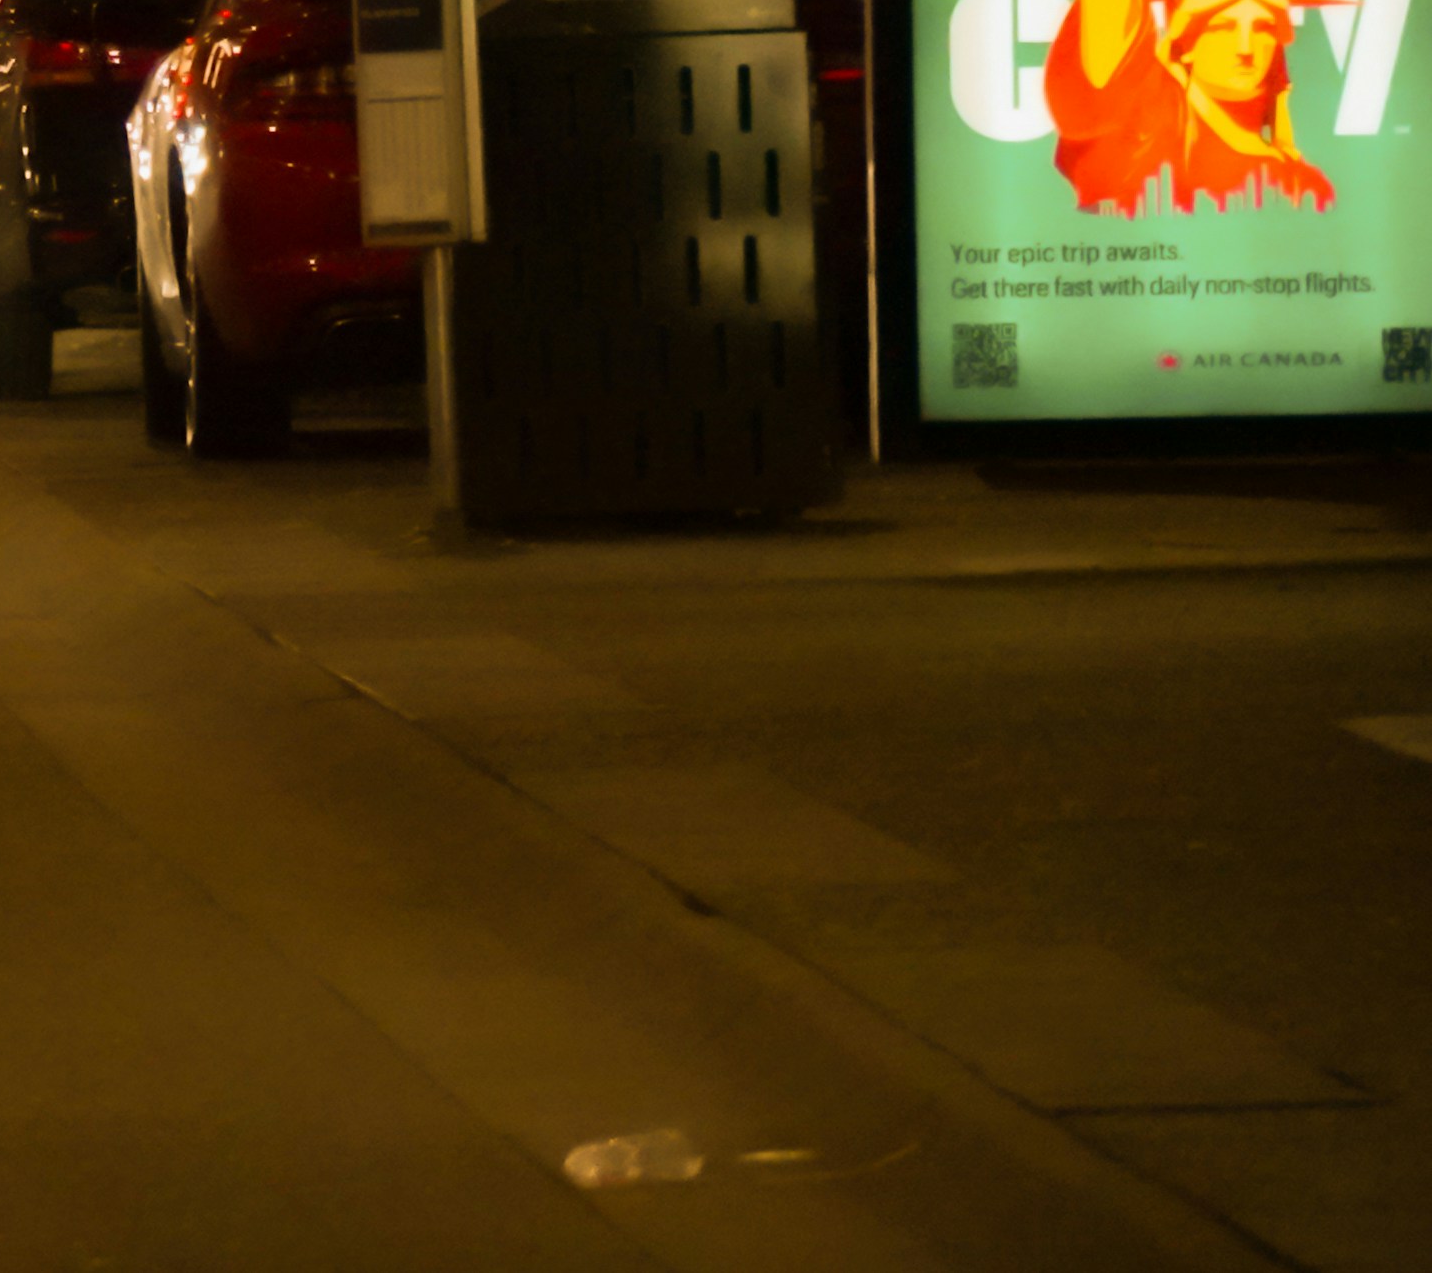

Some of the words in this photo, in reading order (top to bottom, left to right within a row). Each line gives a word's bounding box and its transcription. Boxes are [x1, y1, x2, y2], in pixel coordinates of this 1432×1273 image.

[950, 242, 1002, 264] Your
[1007, 243, 1056, 269] epic
[1061, 242, 1101, 266] trip
[1105, 242, 1185, 263] awaits.
[950, 276, 988, 299] Get
[992, 275, 1050, 299] there
[1053, 275, 1094, 297] fast
[1099, 274, 1145, 297] with
[1149, 274, 1200, 300] daily
[1205, 274, 1301, 298] non-stop
[1305, 271, 1377, 298] flights.
[1192, 350, 1233, 368] AIR
[1239, 350, 1345, 368] CANADA
